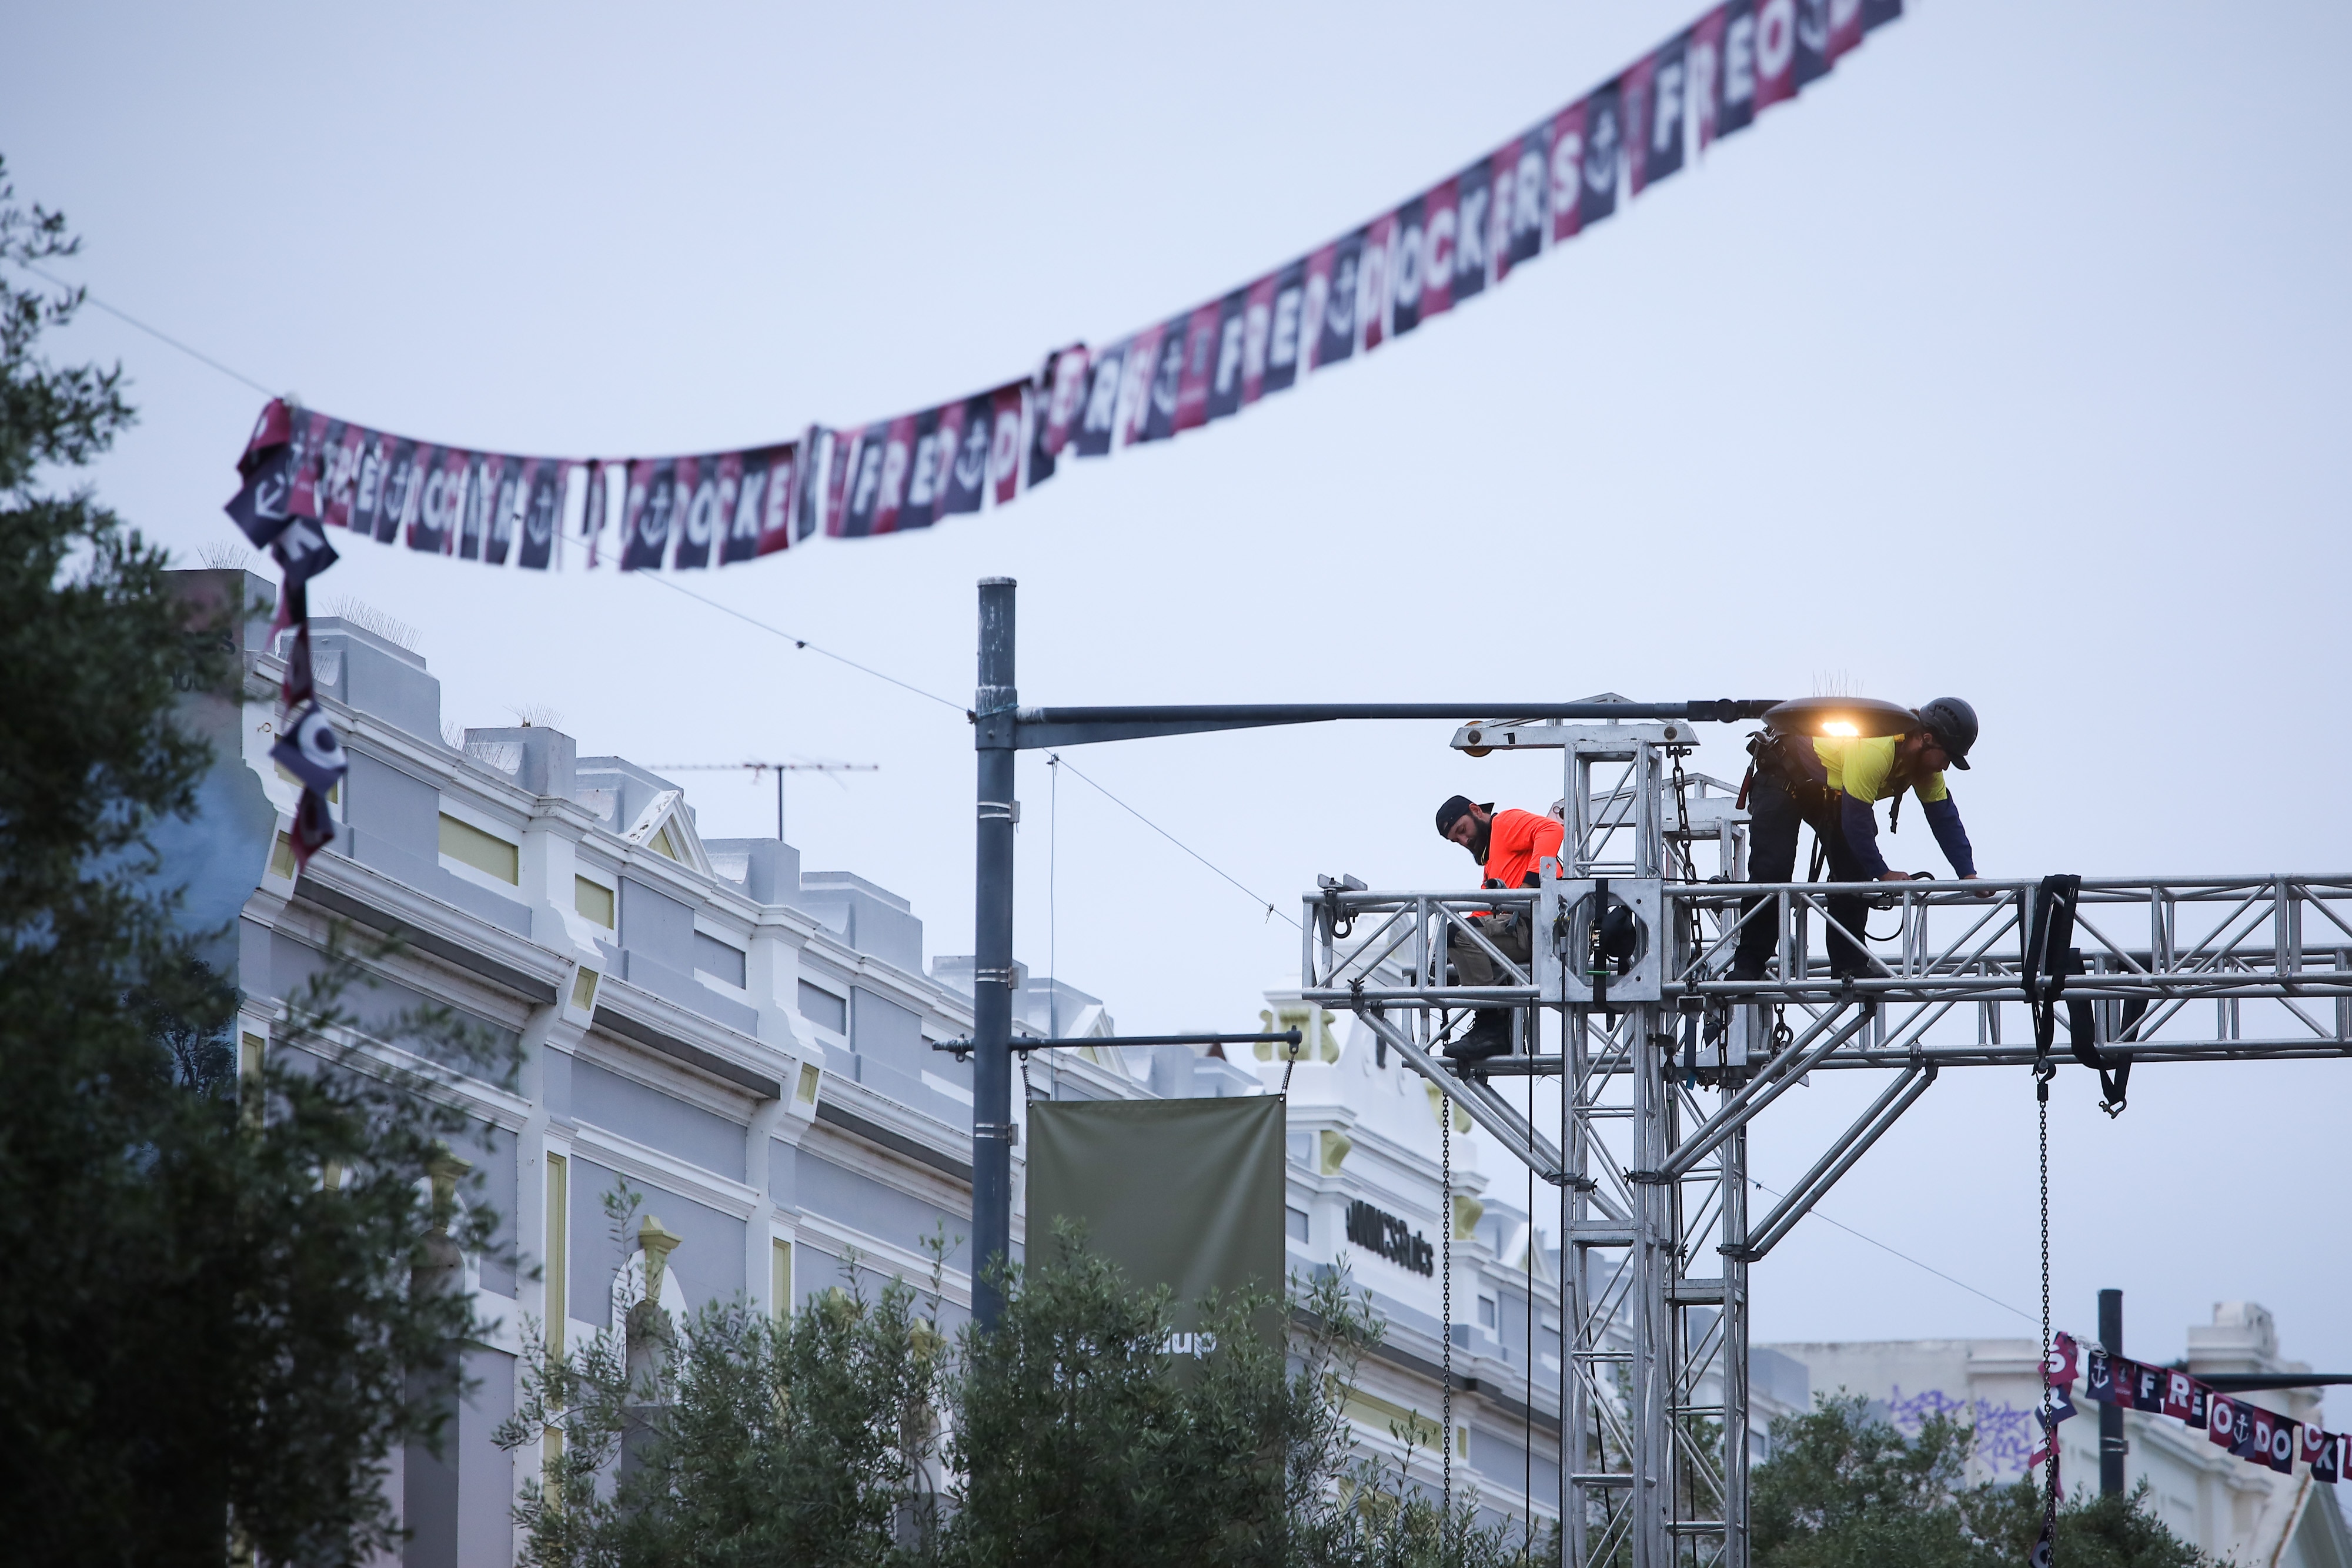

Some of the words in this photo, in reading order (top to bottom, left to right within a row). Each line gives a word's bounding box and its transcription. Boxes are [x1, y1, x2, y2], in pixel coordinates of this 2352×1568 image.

[1358, 132, 1583, 320] DOCKERS
[1655, 0, 1795, 152] FREO
[2140, 1369, 2233, 1433] FREO
[2254, 1420, 2352, 1470] DOCK
